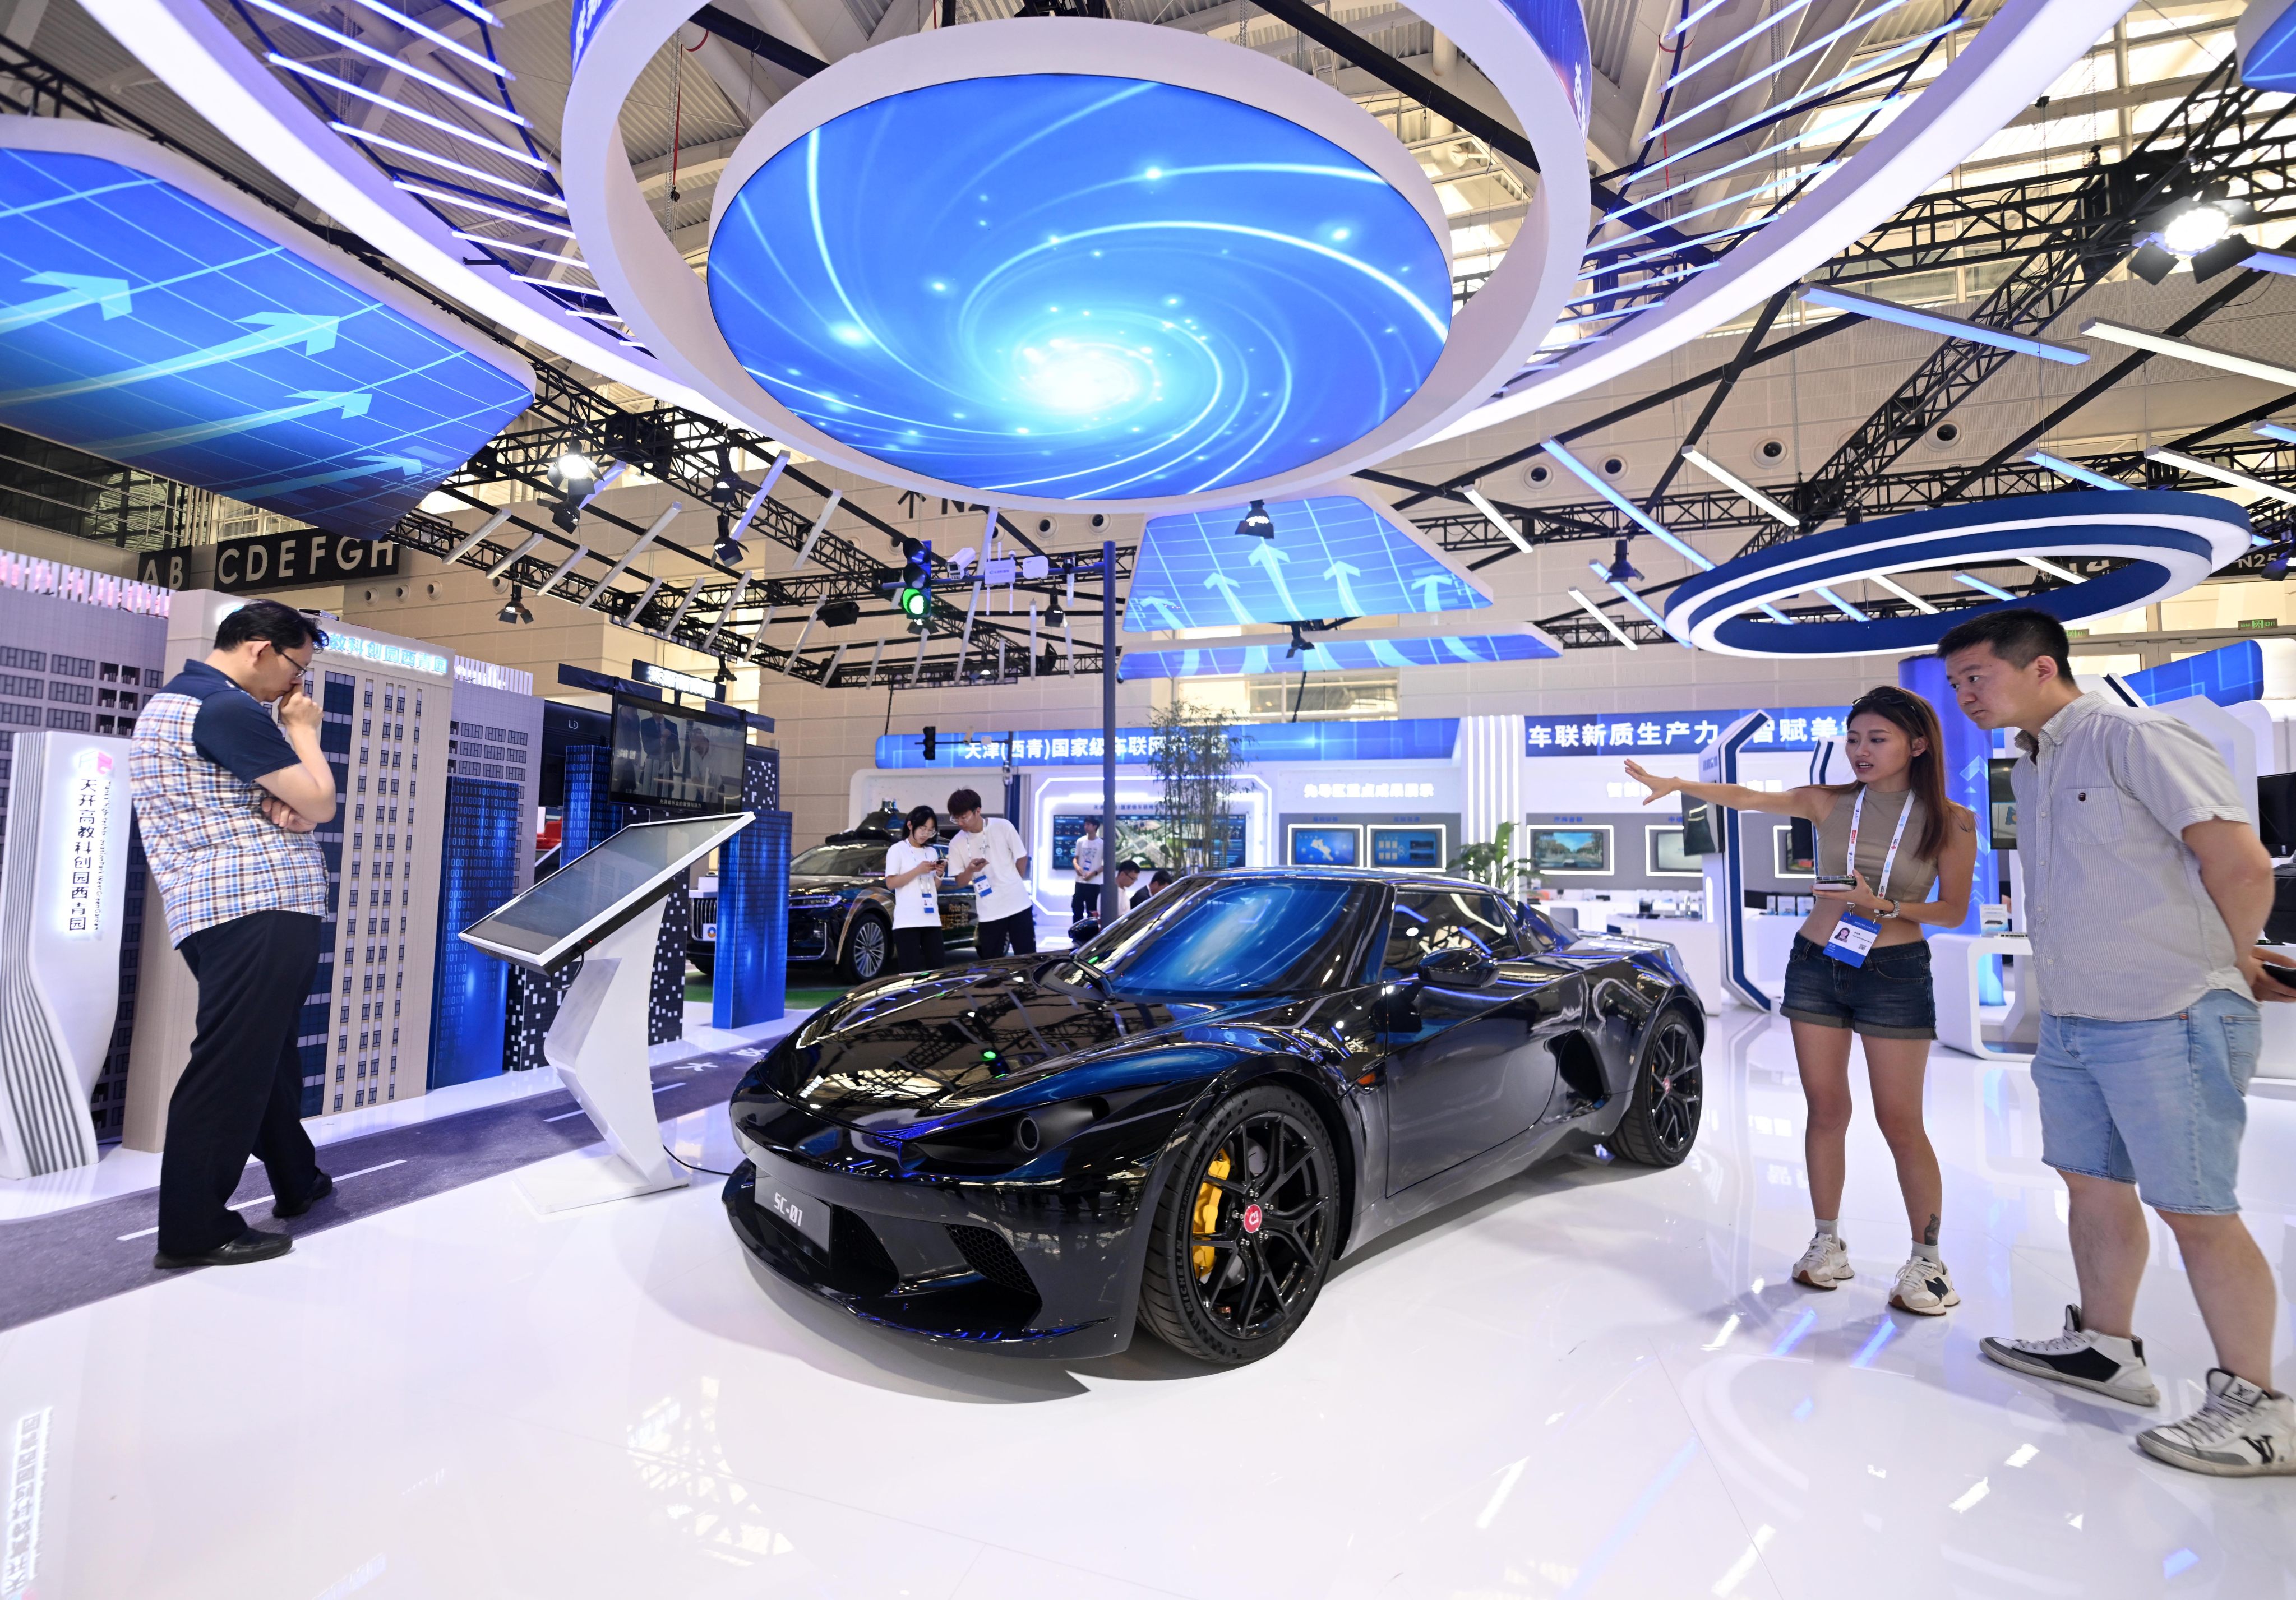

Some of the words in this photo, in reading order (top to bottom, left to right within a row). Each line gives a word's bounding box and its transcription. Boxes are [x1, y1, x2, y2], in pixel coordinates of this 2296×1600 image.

[965, 734, 1229, 761] 天津(西青)国家级车联网
[1528, 720, 1718, 748] 车联新质生产力
[1753, 716, 1849, 744] 智赋美
[70, 779, 96, 931] 天开高教科创园西青园
[774, 1192, 803, 1227] SC-01
[1184, 1182, 1192, 1209] SPORT
[1176, 1240, 1194, 1312] MICHELIN
